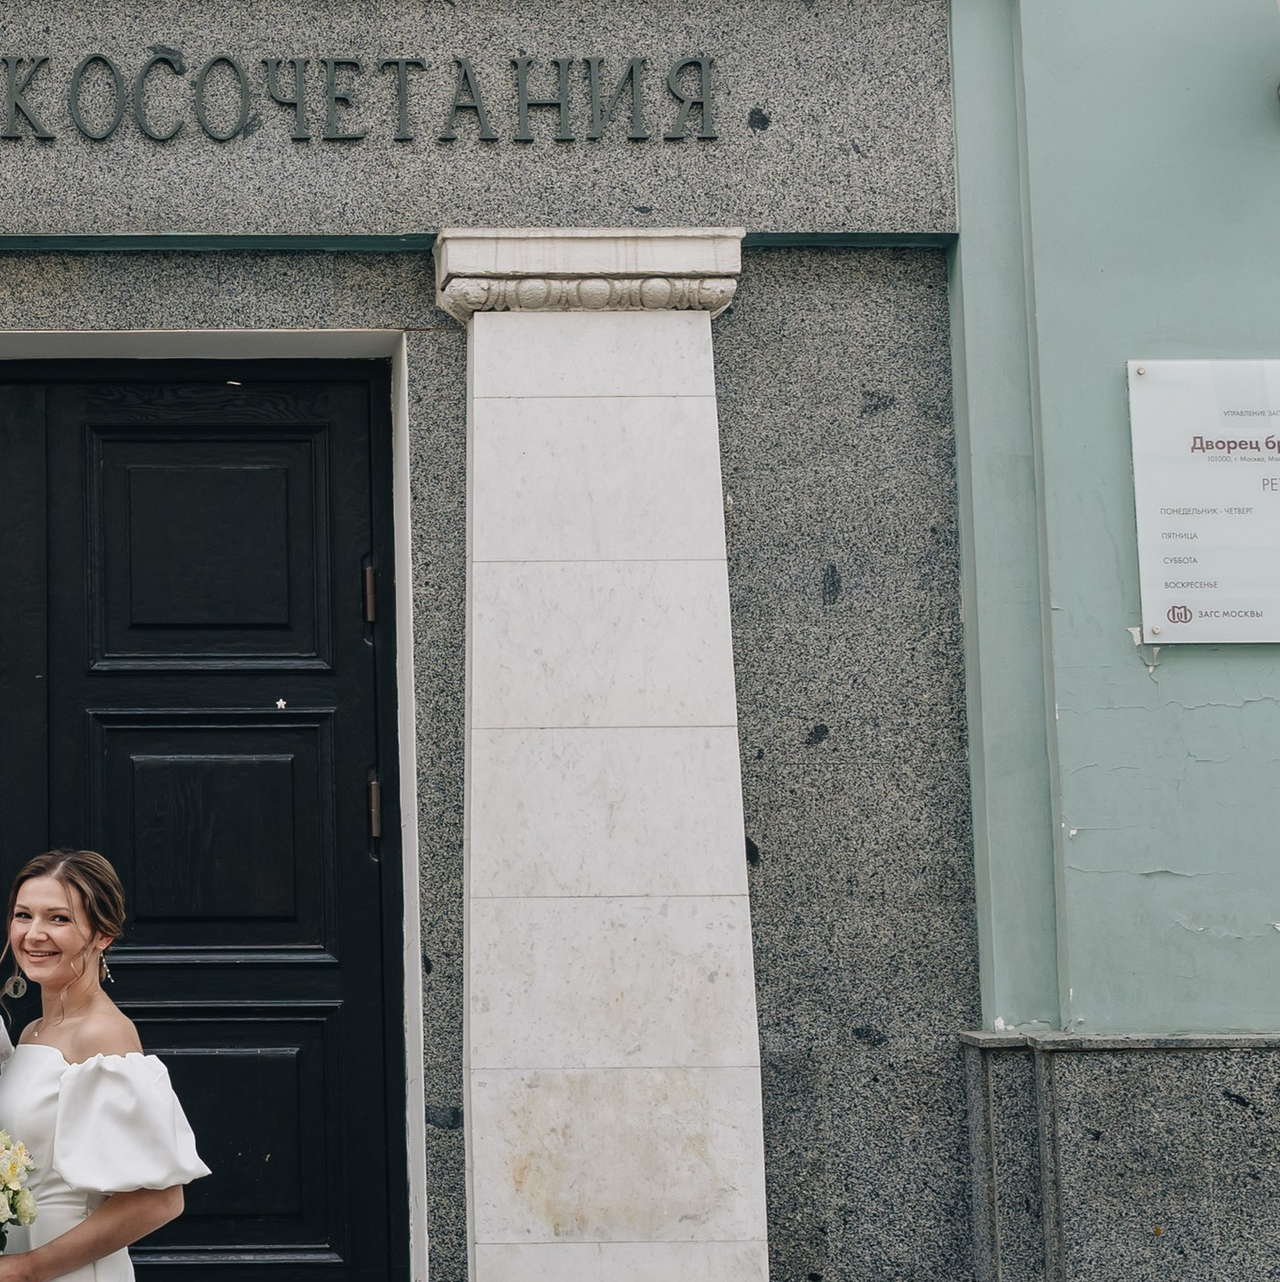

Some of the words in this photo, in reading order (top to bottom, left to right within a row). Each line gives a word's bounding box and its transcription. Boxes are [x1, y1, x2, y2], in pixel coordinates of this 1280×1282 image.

[1191, 436, 1261, 454] Дворец
[1262, 477, 1280, 492] РЕ
[1164, 581, 1219, 589] ВОСКРЕСЕНЬЕ
[1198, 610, 1220, 618] ЗАГС
[1222, 610, 1263, 618] МОСКВЫ
